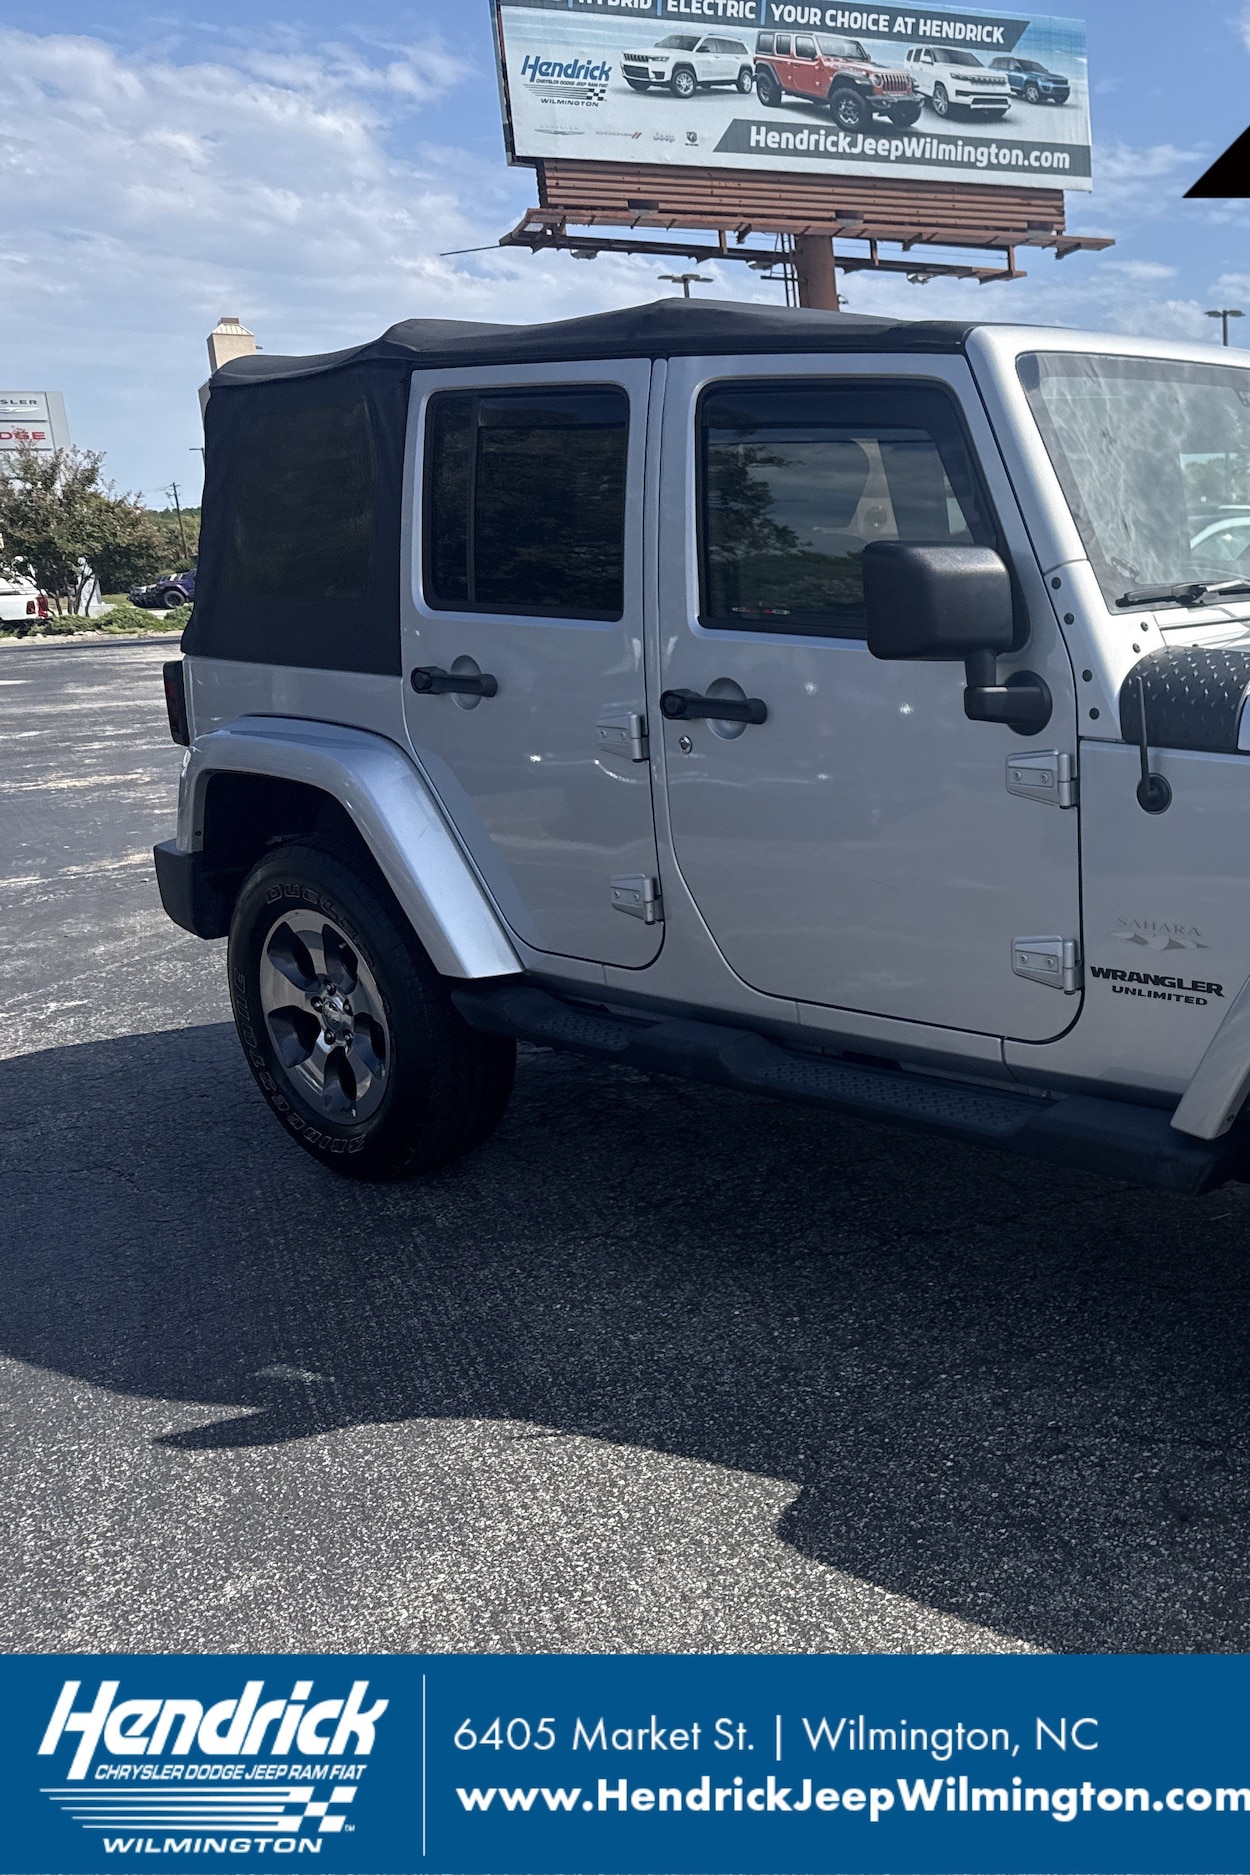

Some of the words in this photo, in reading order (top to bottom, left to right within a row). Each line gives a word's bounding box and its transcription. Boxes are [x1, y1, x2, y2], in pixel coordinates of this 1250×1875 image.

[666, 0, 756, 19] ELECTRIC
[771, 4, 821, 25] YOUR
[824, 11, 889, 33] CHOICE
[892, 17, 916, 36] AT
[918, 19, 1005, 44] HENDRICK
[521, 55, 612, 82] Hendrick
[541, 98, 599, 107] WILMINGTON
[750, 126, 1071, 169] HendrickJeepWilmington.com
[1117, 917, 1201, 937] SAHARA
[1090, 966, 1225, 997] WRANGLER
[1112, 985, 1208, 1006] UNLIMITED
